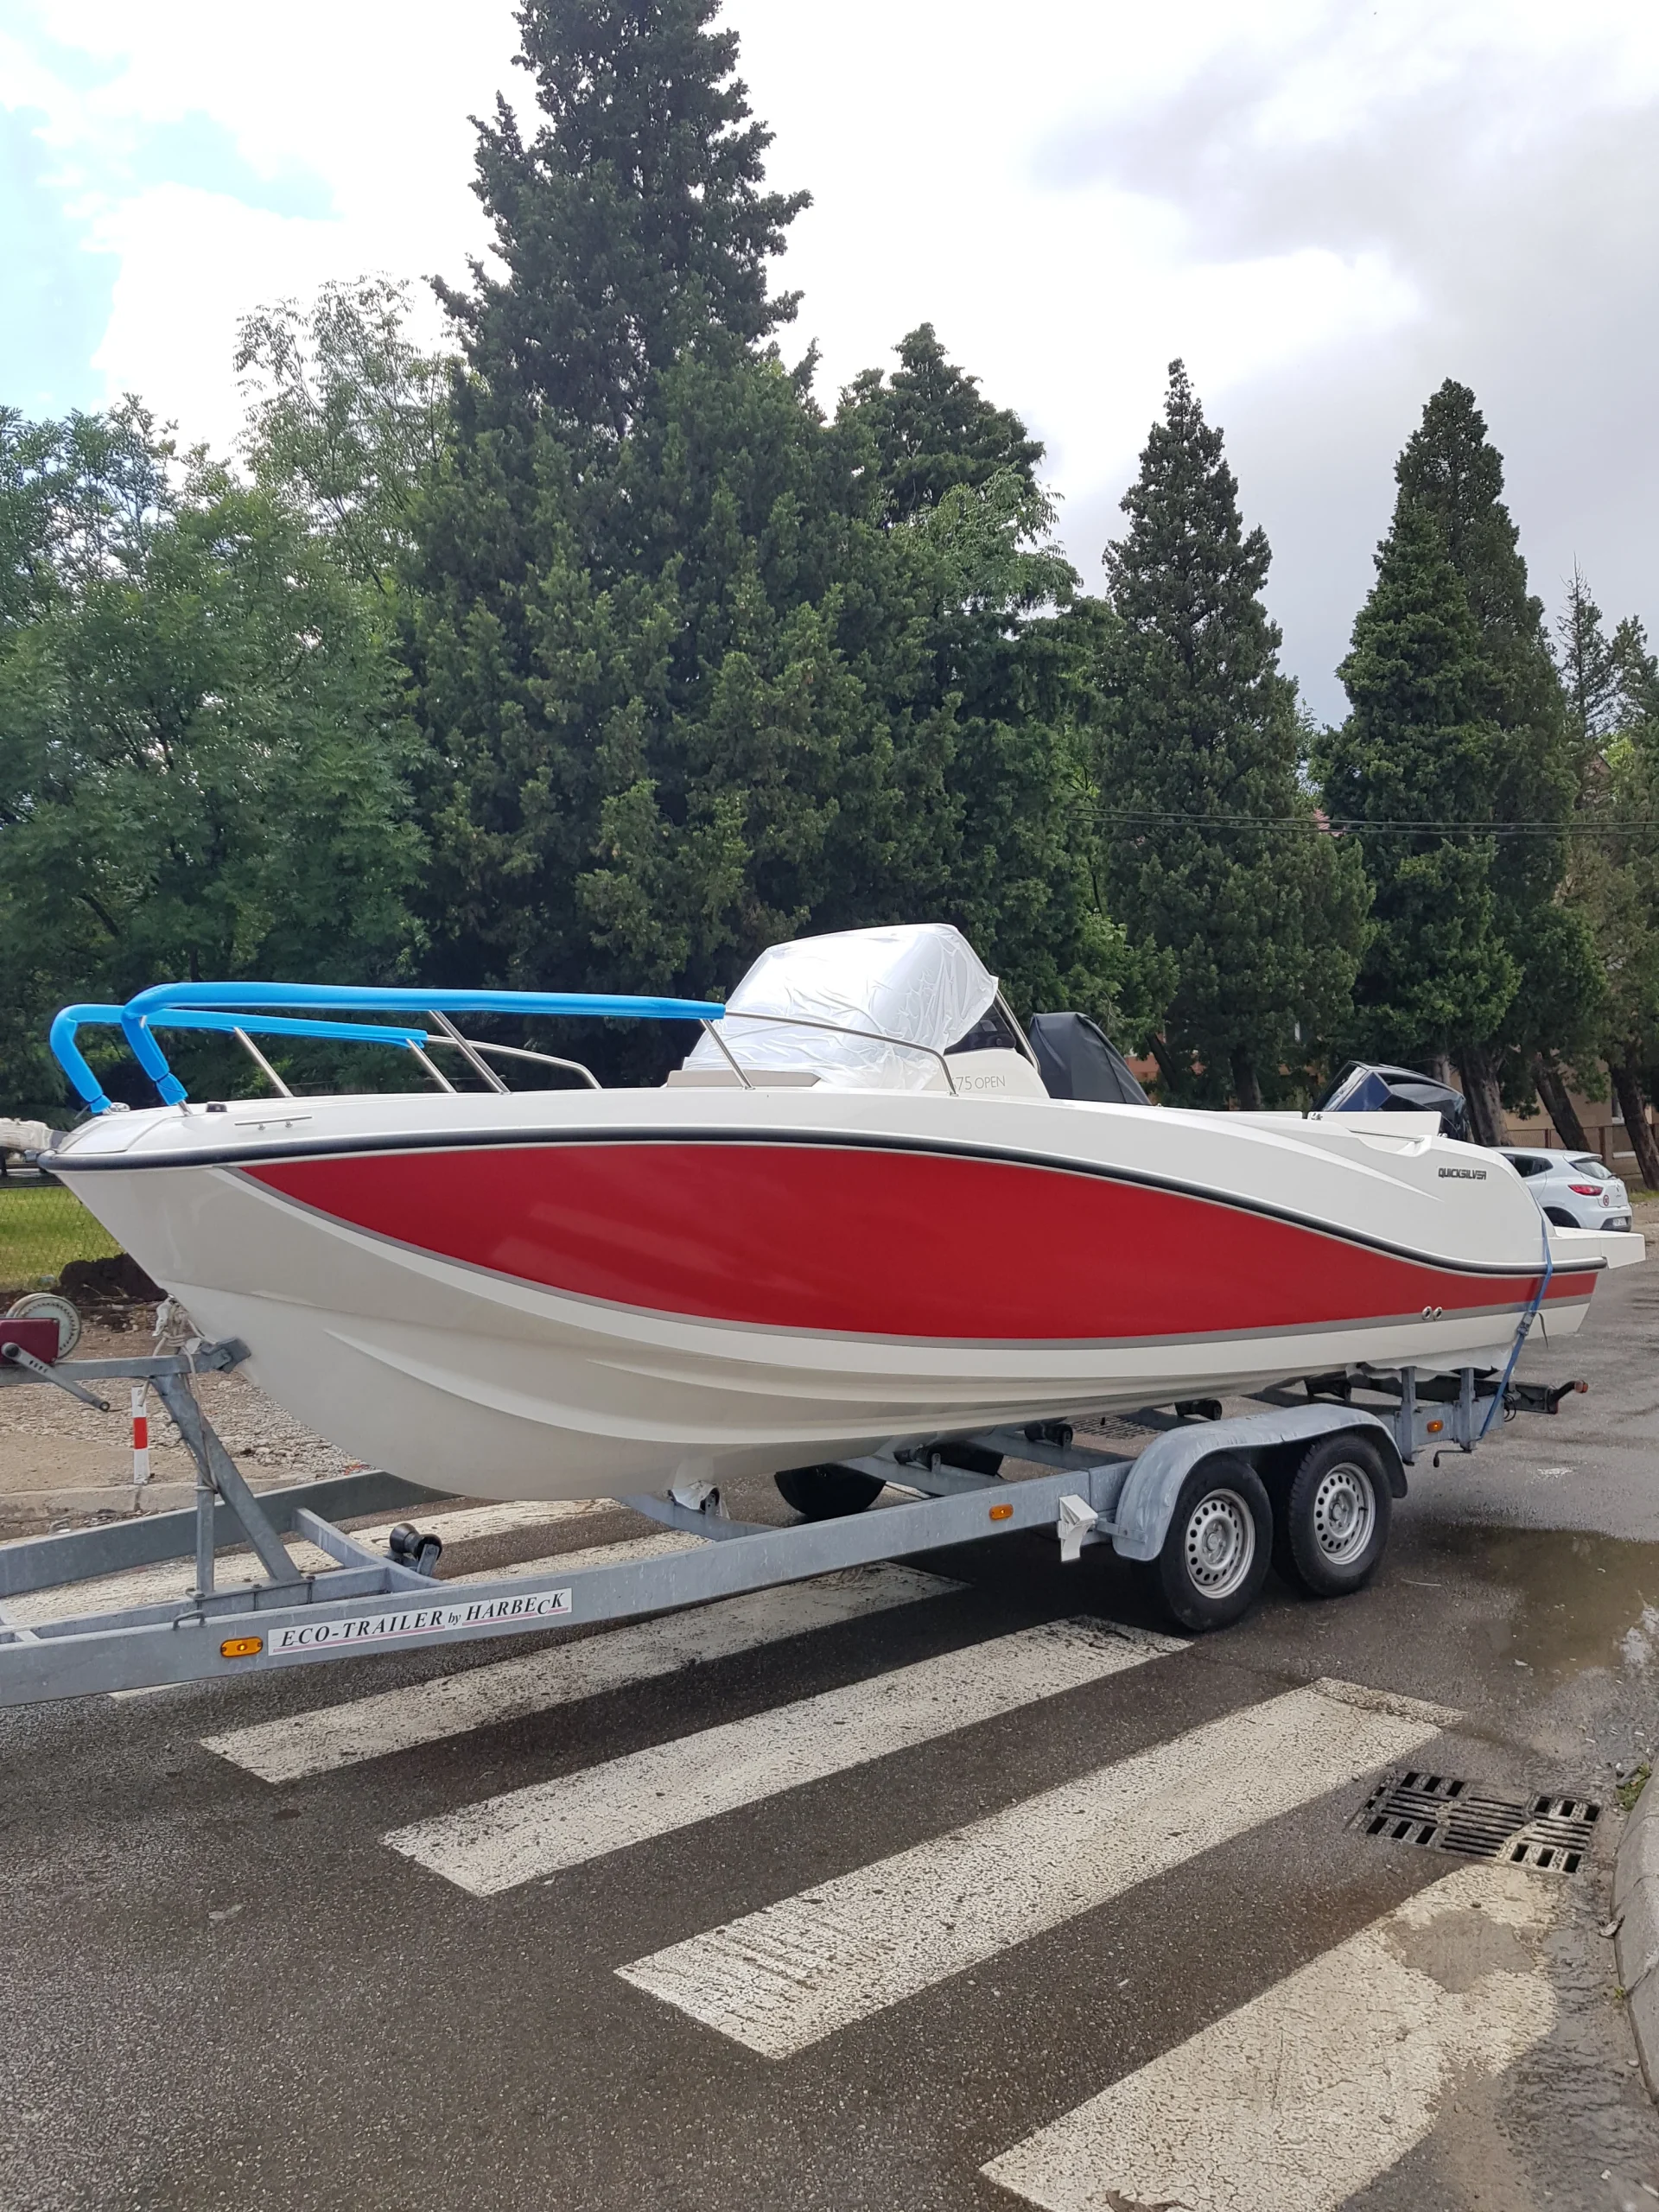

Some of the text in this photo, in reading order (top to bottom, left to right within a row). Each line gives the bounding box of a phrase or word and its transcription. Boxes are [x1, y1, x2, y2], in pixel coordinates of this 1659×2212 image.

[951, 1076, 1006, 1090] 75 OPEN
[1438, 1167, 1487, 1180] QUICKSILVER
[281, 1592, 565, 1647] ECO-TRAILER by HARBECK
